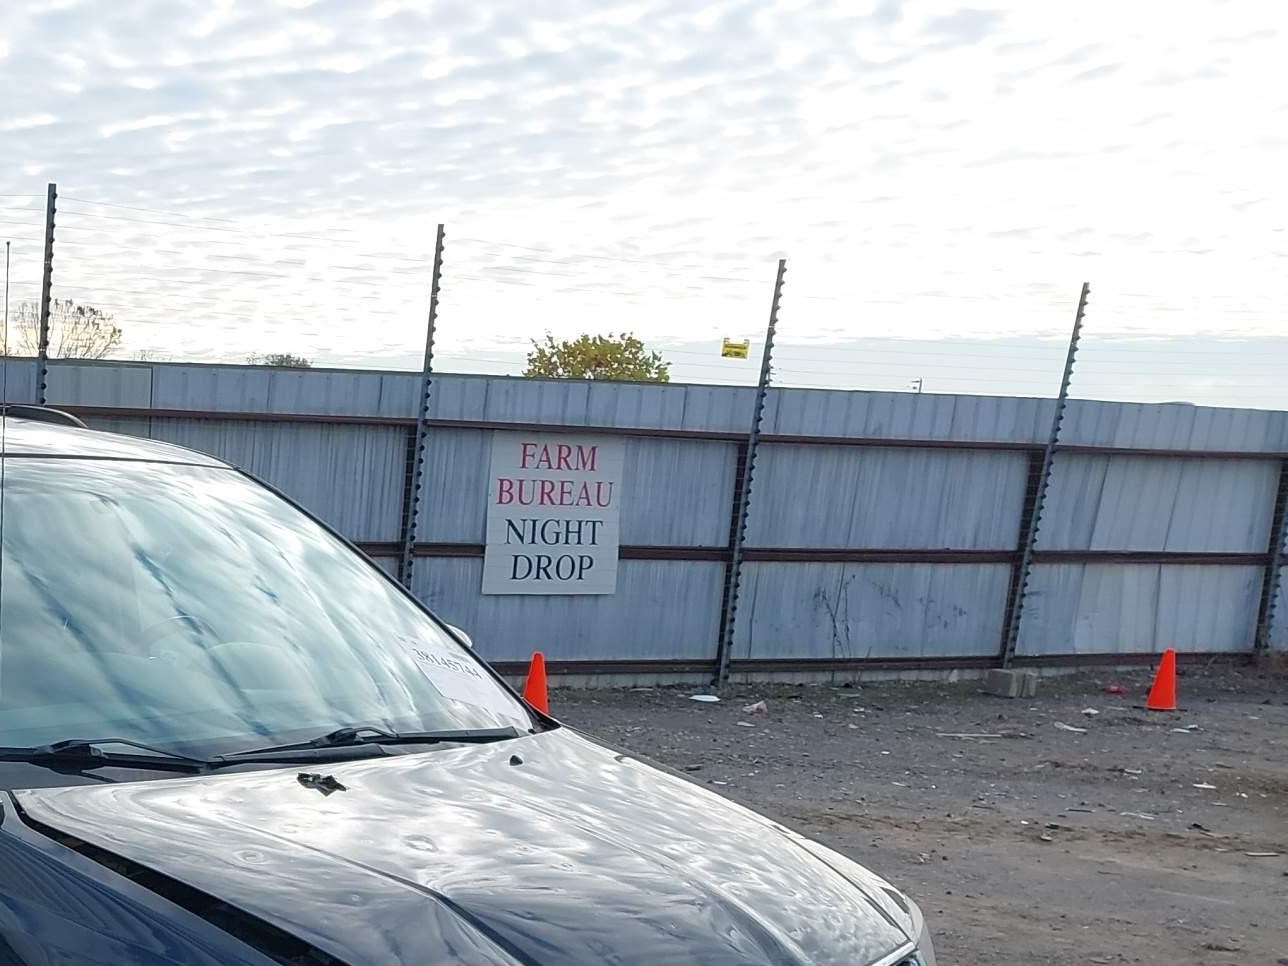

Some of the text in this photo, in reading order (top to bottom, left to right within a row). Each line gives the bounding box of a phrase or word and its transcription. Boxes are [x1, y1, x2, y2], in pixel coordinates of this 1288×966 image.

[520, 443, 598, 471] FARM
[496, 478, 614, 507] BUREAU
[504, 518, 604, 545] NIGHT
[511, 554, 594, 580] DROP
[412, 648, 482, 680] 38145744
